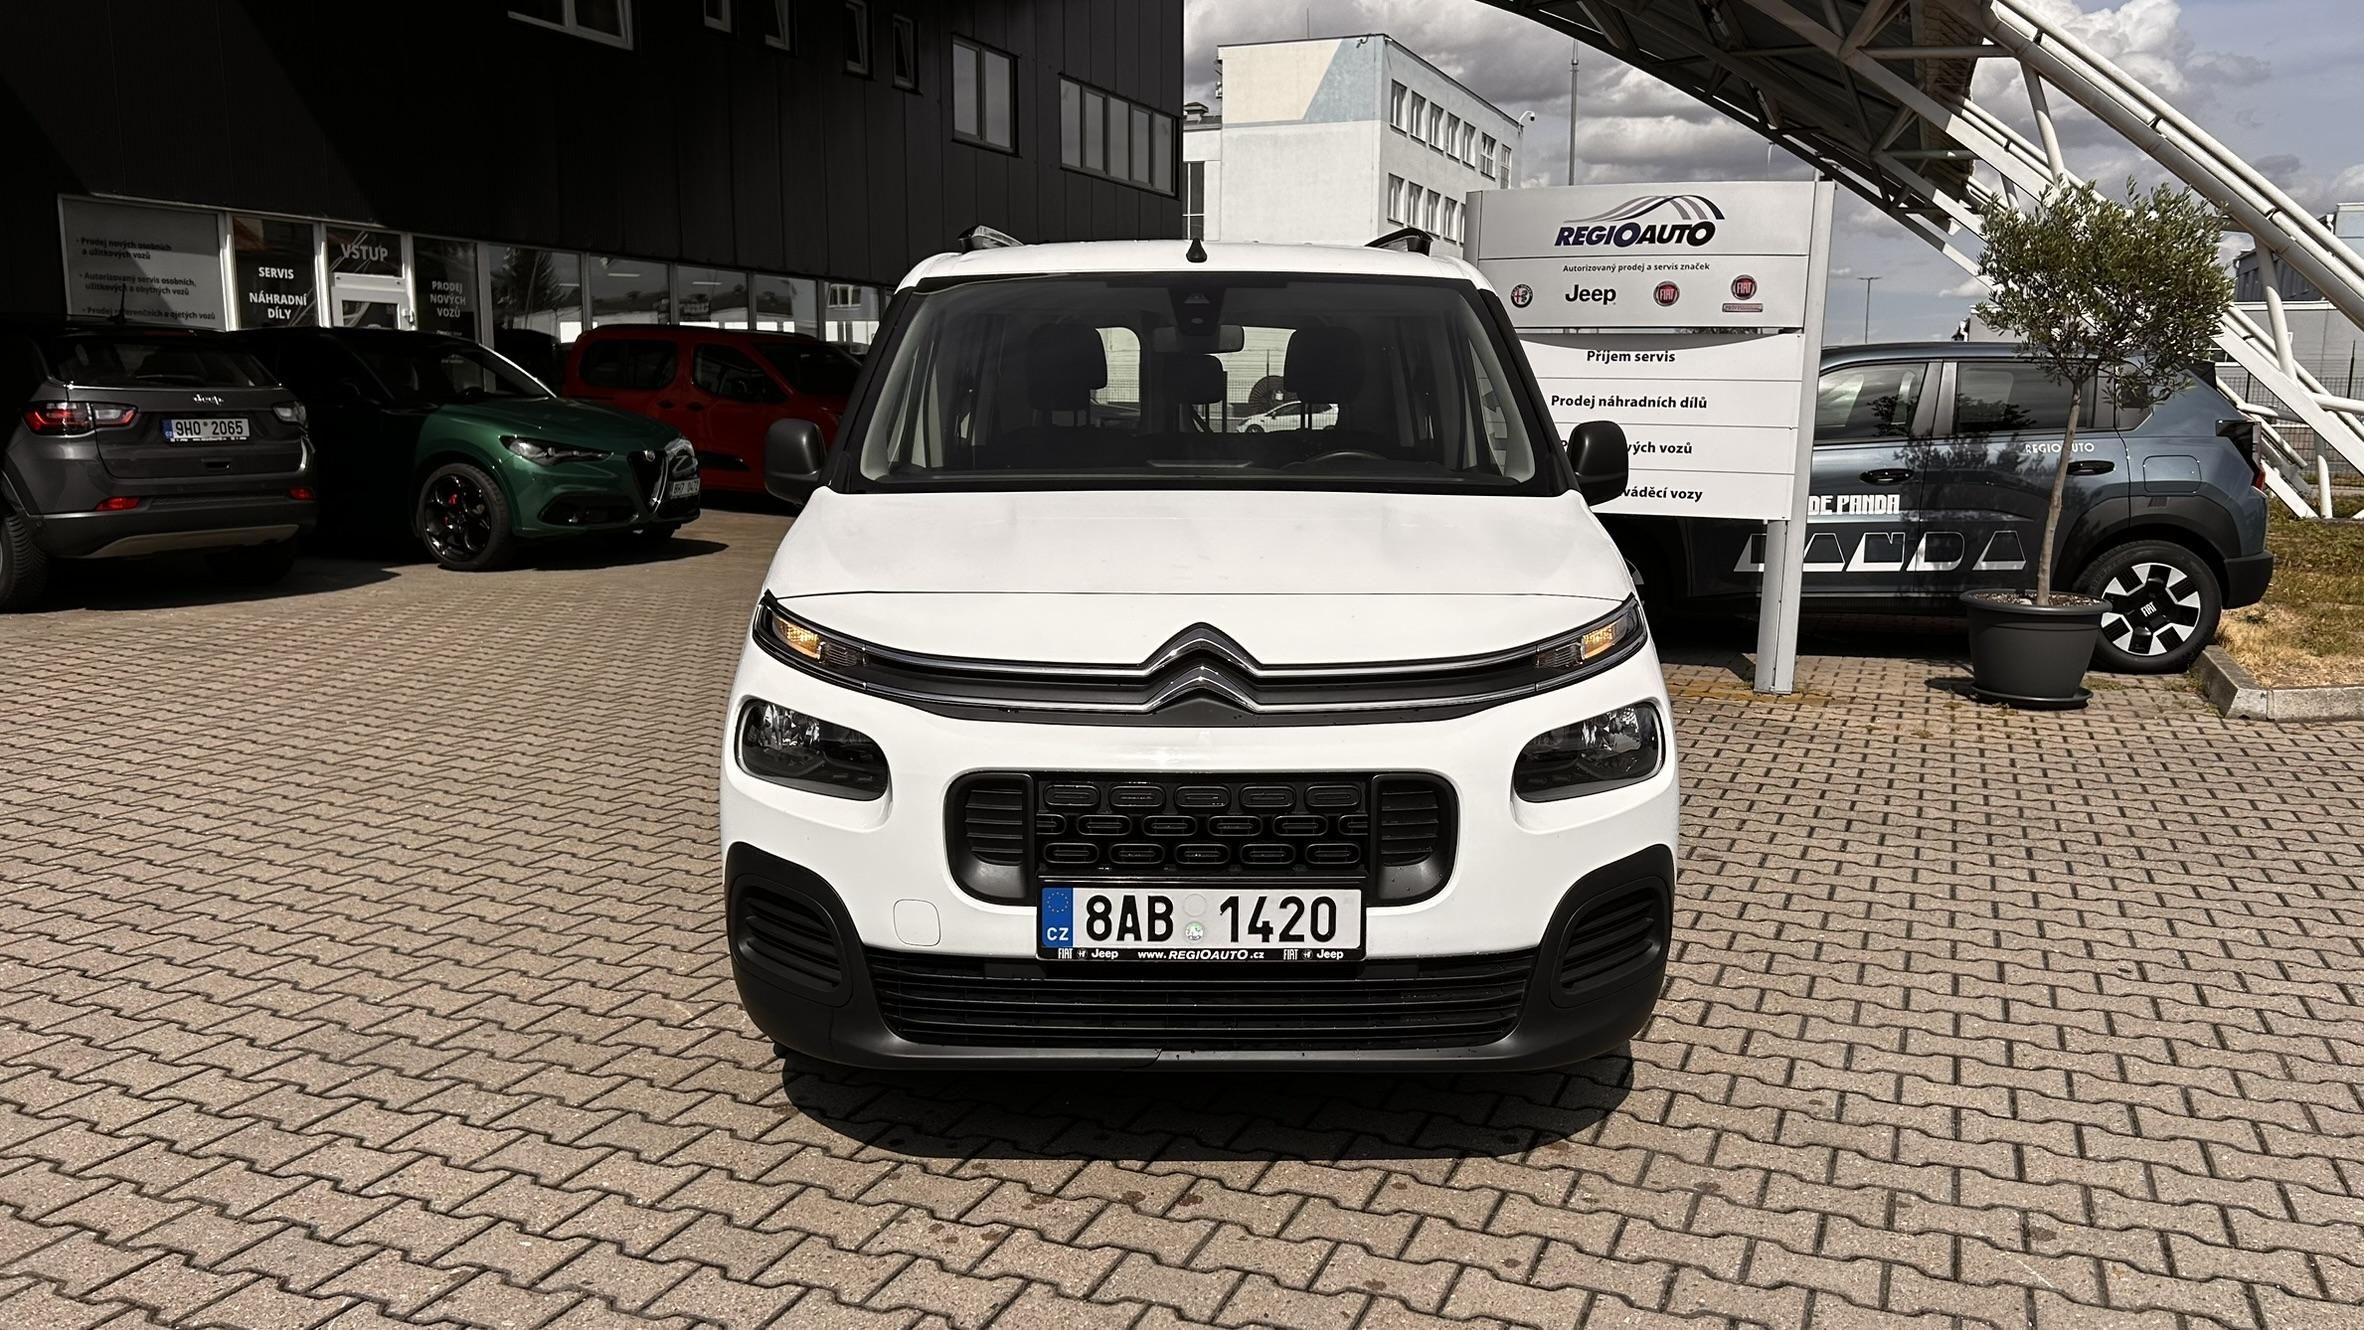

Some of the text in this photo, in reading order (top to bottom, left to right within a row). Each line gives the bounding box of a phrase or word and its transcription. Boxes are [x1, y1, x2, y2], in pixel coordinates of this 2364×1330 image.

[1554, 220, 1716, 248] REGIOAUTO
[341, 243, 389, 262] VSTUP
[258, 266, 295, 280] SERVIS
[1562, 264, 1616, 273] Autorizovaný
[1617, 264, 1645, 273] prodej
[1653, 263, 1679, 271] servis
[1680, 262, 1710, 271] značek
[432, 280, 463, 294] PRODEJ
[1565, 283, 1617, 305] Jeep
[249, 290, 307, 306] NÁHRADNÍ
[429, 292, 466, 305] NOVÝCH
[267, 305, 292, 320] DÍLY
[1586, 349, 1676, 364] Příjem servis
[1551, 395, 1708, 409] Prodej náhradních dílů
[211, 420, 243, 435] 2065
[1659, 442, 1693, 454] vozů
[2025, 442, 2095, 454] REGIOUTO
[1670, 490, 1703, 502] vozy
[1837, 494, 1900, 515] PANDA
[1085, 894, 1337, 943] 8AB 1420
[1046, 928, 1069, 942] CZ
[1058, 948, 1073, 959] FIAT
[1091, 948, 1119, 960] Jeep
[1283, 948, 1298, 960] FIAT
[1316, 948, 1344, 960] Jeep
